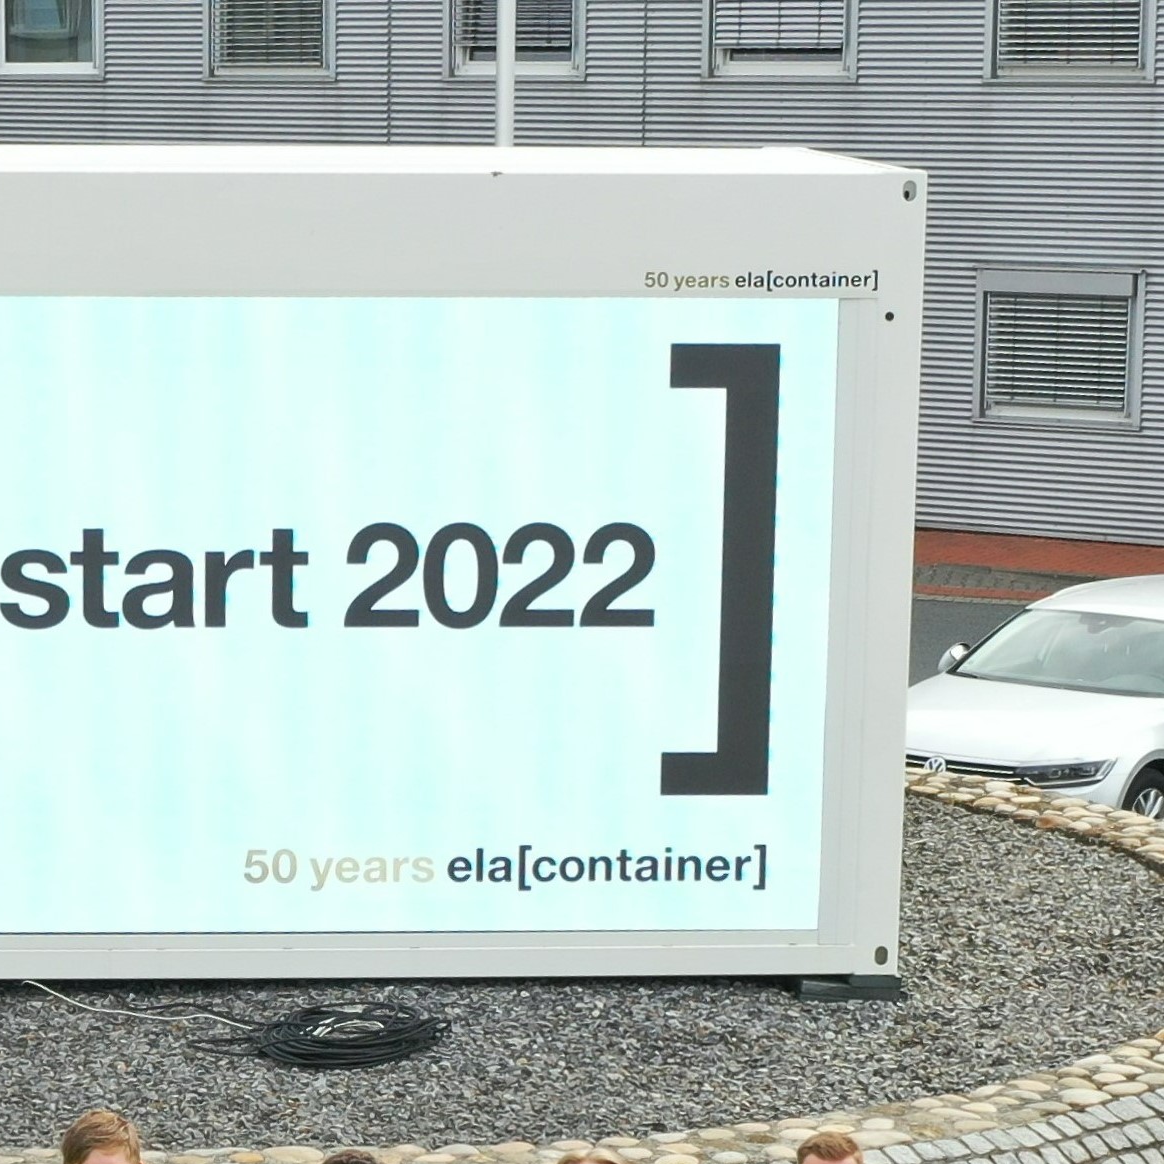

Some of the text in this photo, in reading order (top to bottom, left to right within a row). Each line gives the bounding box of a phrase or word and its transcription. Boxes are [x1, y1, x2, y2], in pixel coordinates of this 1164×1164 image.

[644, 270, 878, 291] 50 years ela[container]
[344, 522, 655, 629] 2022
[244, 844, 767, 891] 50 years ela[container]
